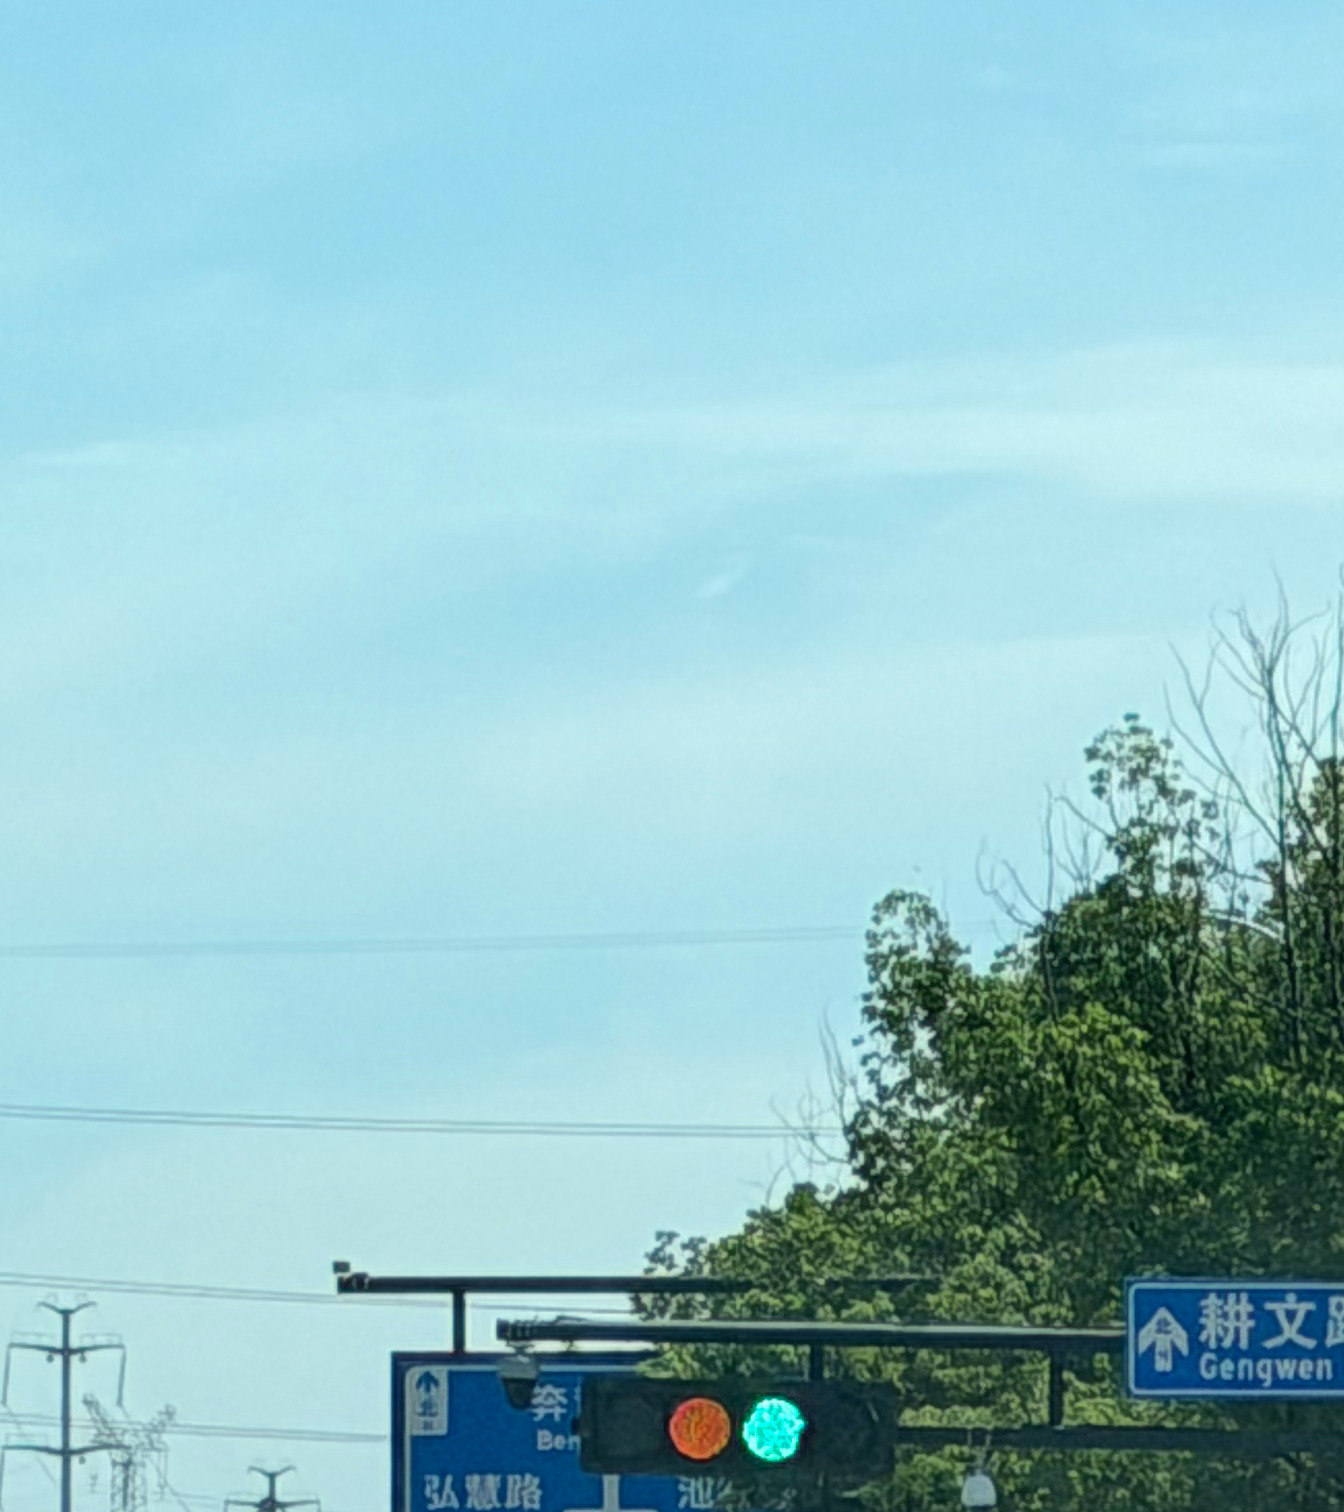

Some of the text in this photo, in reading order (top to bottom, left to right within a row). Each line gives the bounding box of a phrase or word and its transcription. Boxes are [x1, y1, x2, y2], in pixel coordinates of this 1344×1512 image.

[1198, 1352, 1333, 1388] Gengwen
[536, 1429, 582, 1451] Ben
[423, 1473, 543, 1511] 弘慧路
